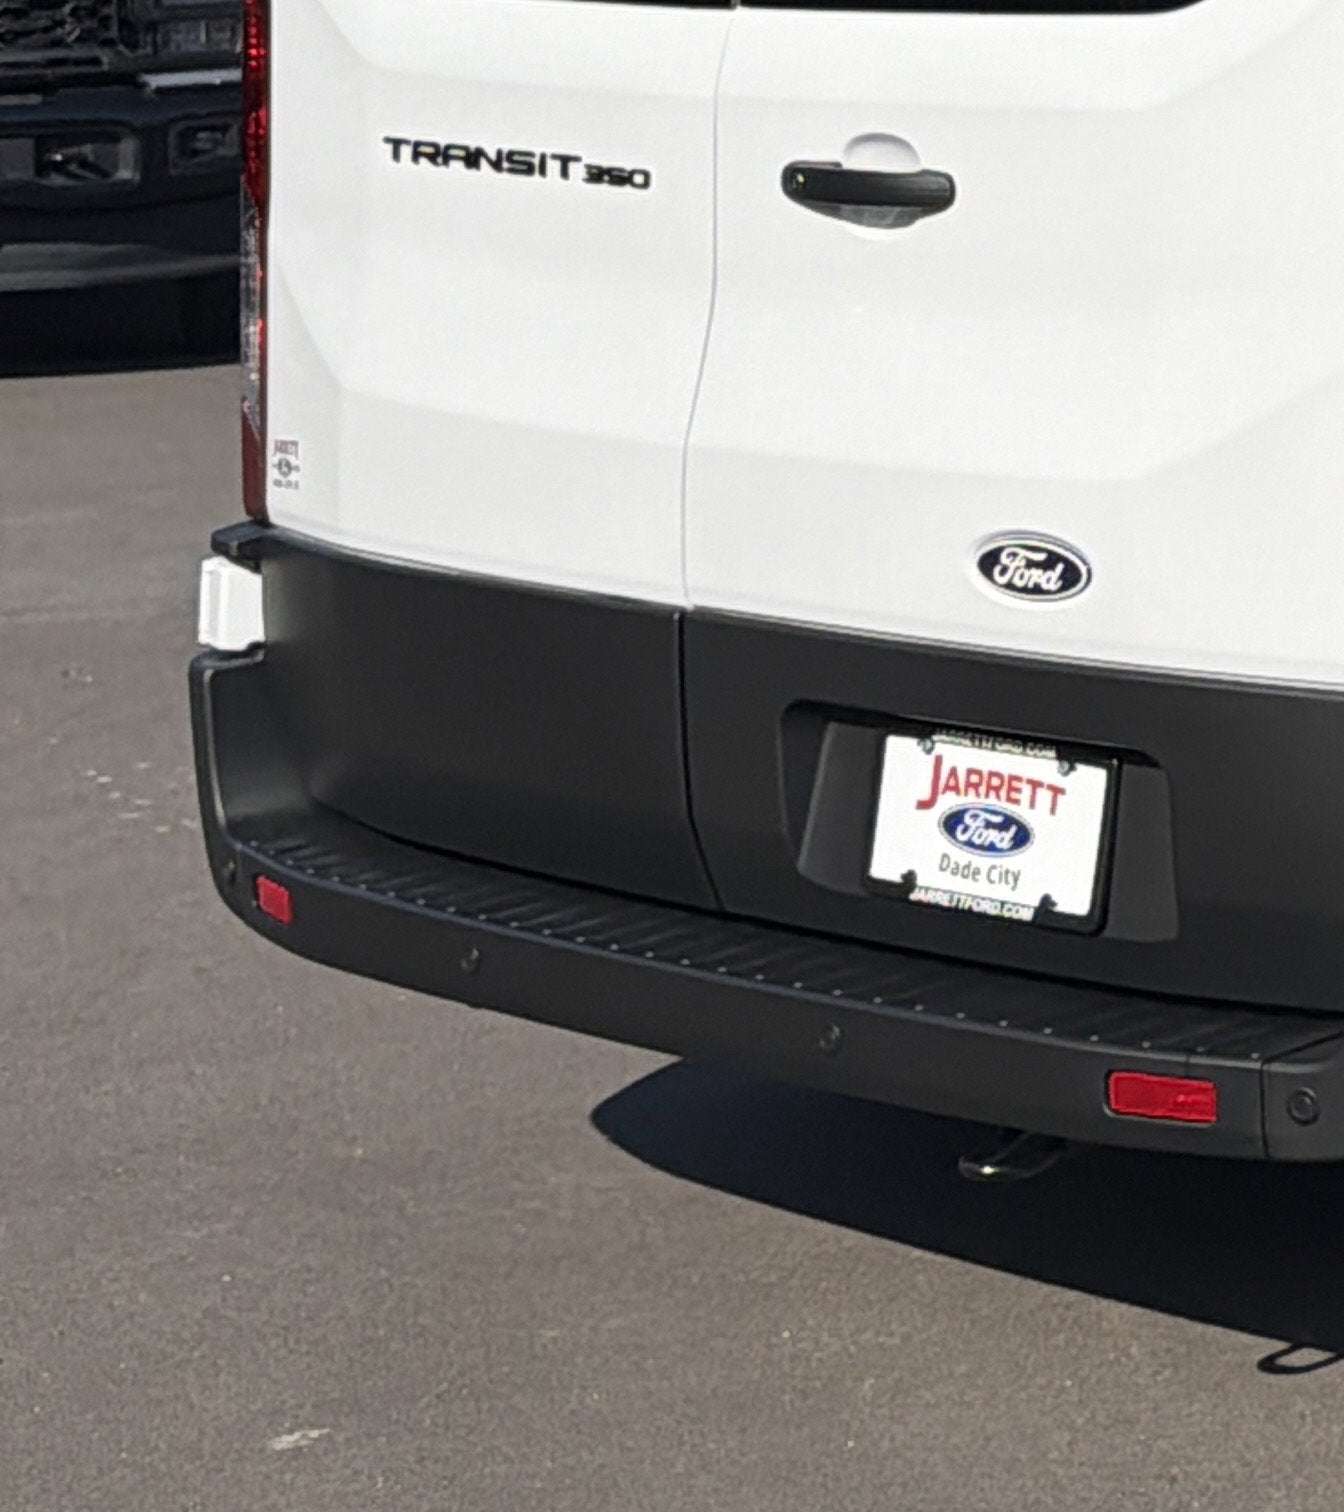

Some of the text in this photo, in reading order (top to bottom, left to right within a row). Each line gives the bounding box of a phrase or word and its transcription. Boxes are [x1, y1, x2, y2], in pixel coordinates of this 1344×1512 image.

[382, 136, 582, 181] TRANSIT
[992, 547, 1065, 591] Ford
[915, 754, 1066, 816] JARRETT
[955, 808, 1018, 850] Ford
[938, 852, 1022, 892] Dade City
